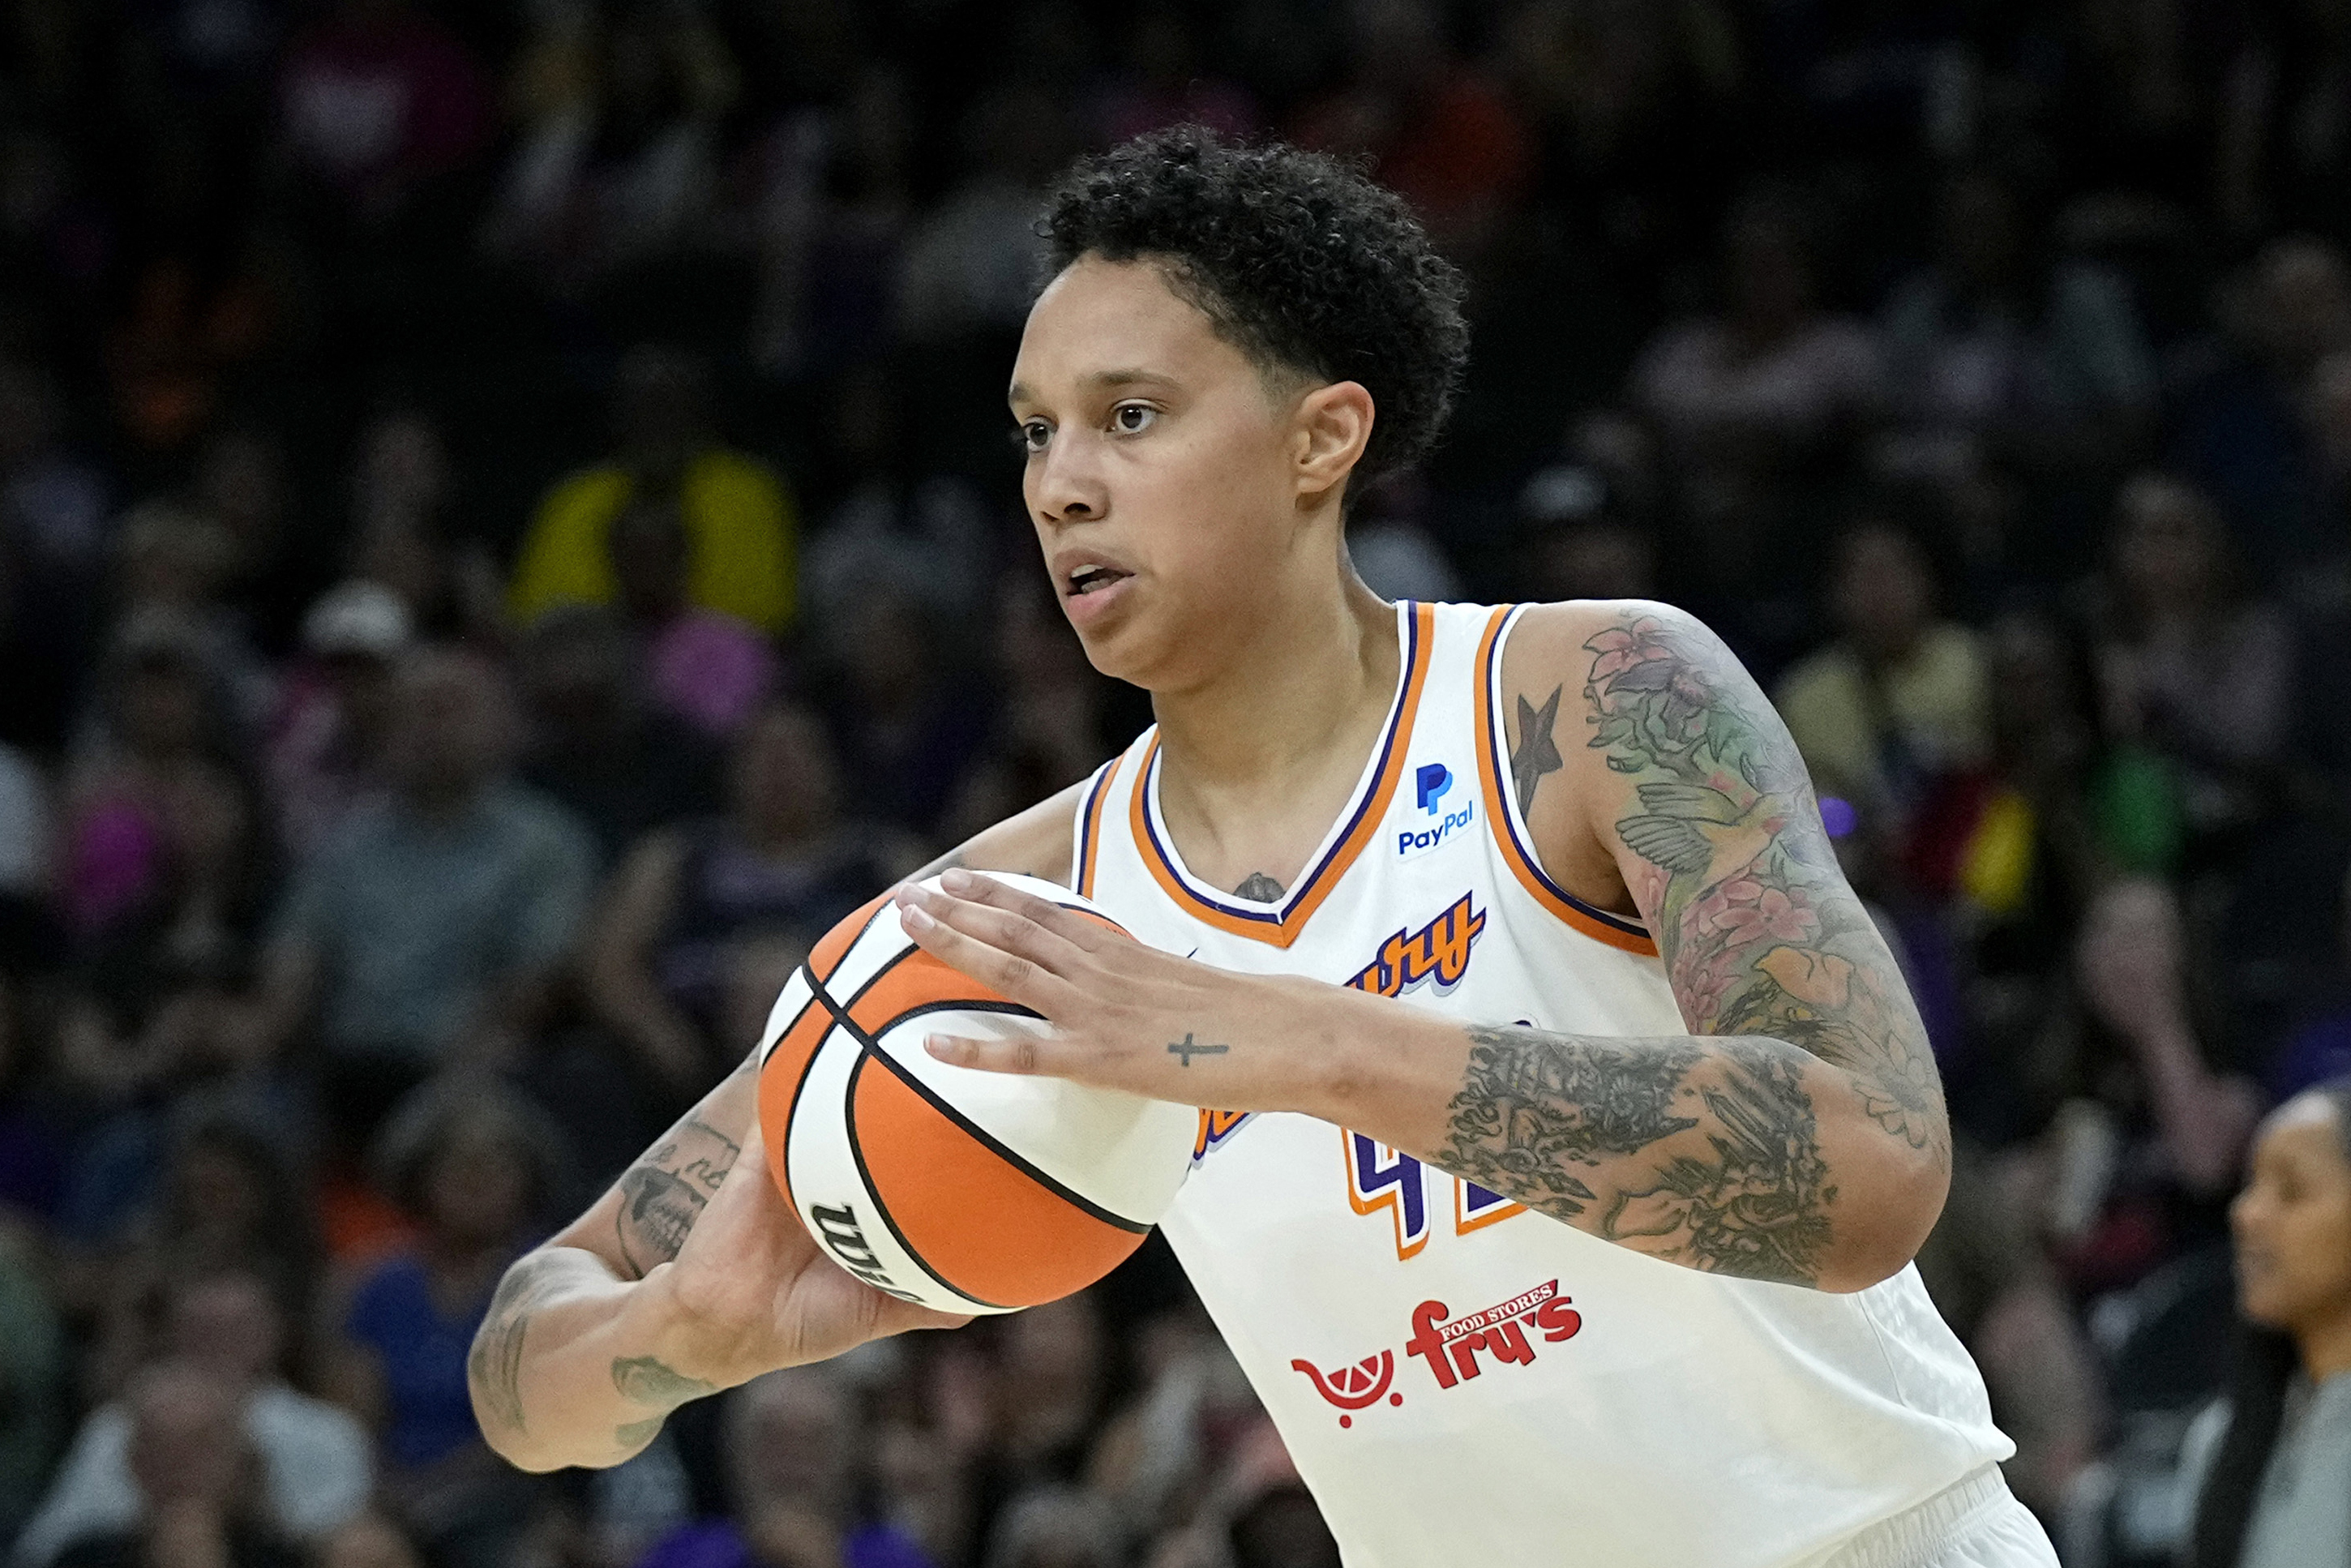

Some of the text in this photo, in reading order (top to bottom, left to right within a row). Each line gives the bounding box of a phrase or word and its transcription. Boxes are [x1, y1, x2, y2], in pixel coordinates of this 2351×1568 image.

[1398, 799, 1473, 855] PayPal
[1341, 1126, 1531, 1262] 4
[810, 1202, 927, 1303] Wil
[1438, 1284, 1553, 1341] FOOD STORES
